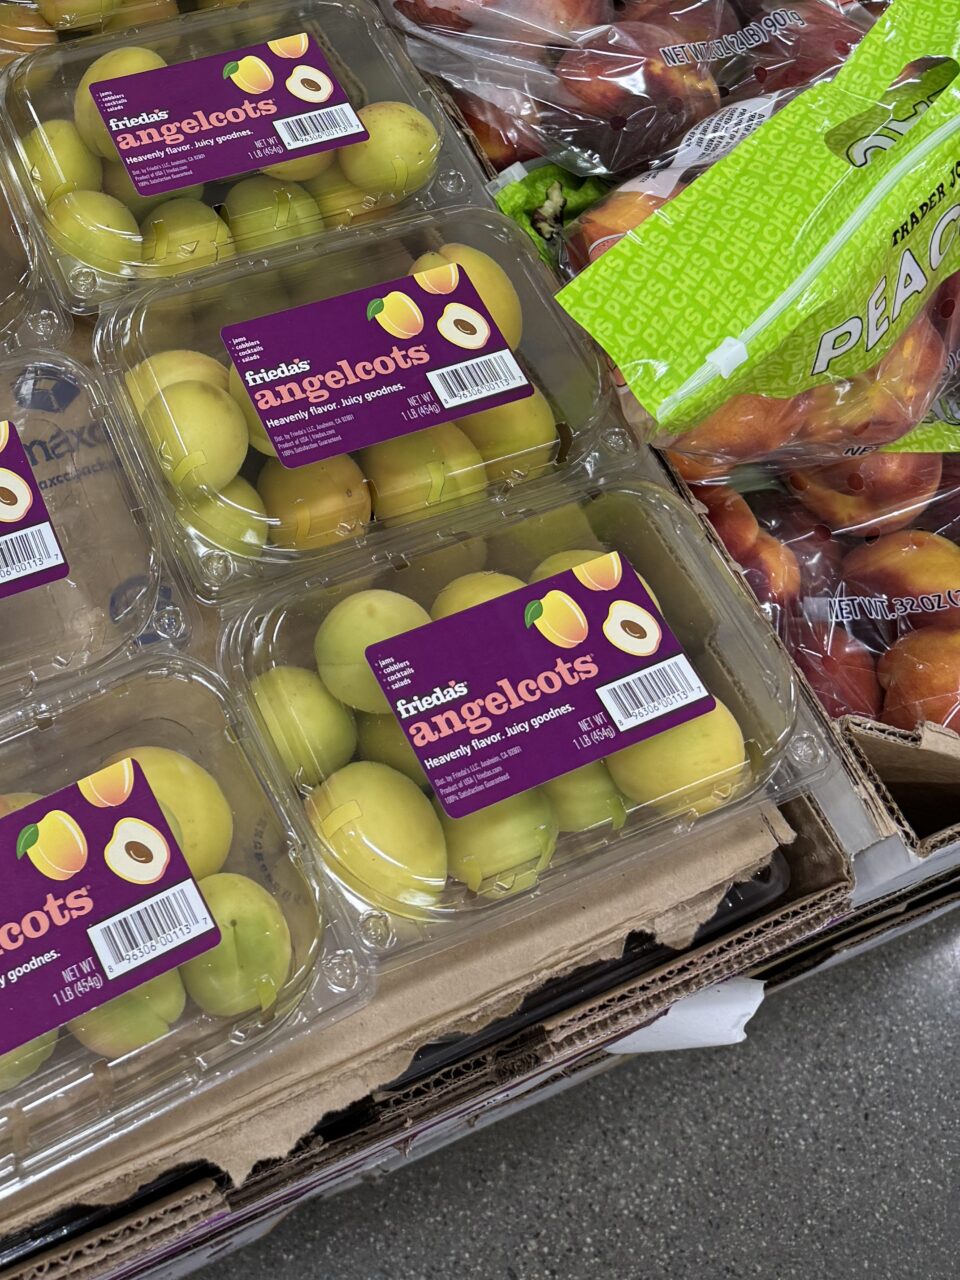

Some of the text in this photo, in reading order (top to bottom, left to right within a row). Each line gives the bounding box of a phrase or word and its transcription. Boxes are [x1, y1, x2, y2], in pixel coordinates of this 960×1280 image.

[108, 108, 168, 131] frieda's
[115, 98, 277, 149] angelcots
[125, 129, 253, 164] Heavenly flavor. Juicy goodnes.
[892, 182, 946, 248] TRADER
[244, 358, 310, 386] frieda's
[253, 344, 430, 409] angelcots
[265, 383, 405, 428] Heavenly flavor. Juicy goodnes.
[400, 402, 440, 420] 1 LB (454g)
[406, 391, 434, 406] NET WT
[828, 596, 860, 621] NET
[395, 680, 468, 718] frieda's
[408, 654, 599, 746] angelcots
[423, 703, 575, 769] Heavenly flavor. Juicy goodnes.
[572, 725, 615, 749] 1 LB (454g)
[577, 711, 607, 731] NET WT
[7, 949, 60, 982] goodnes.
[61, 956, 95, 983] NET WT
[52, 972, 102, 1005] 1 LB (454g)
